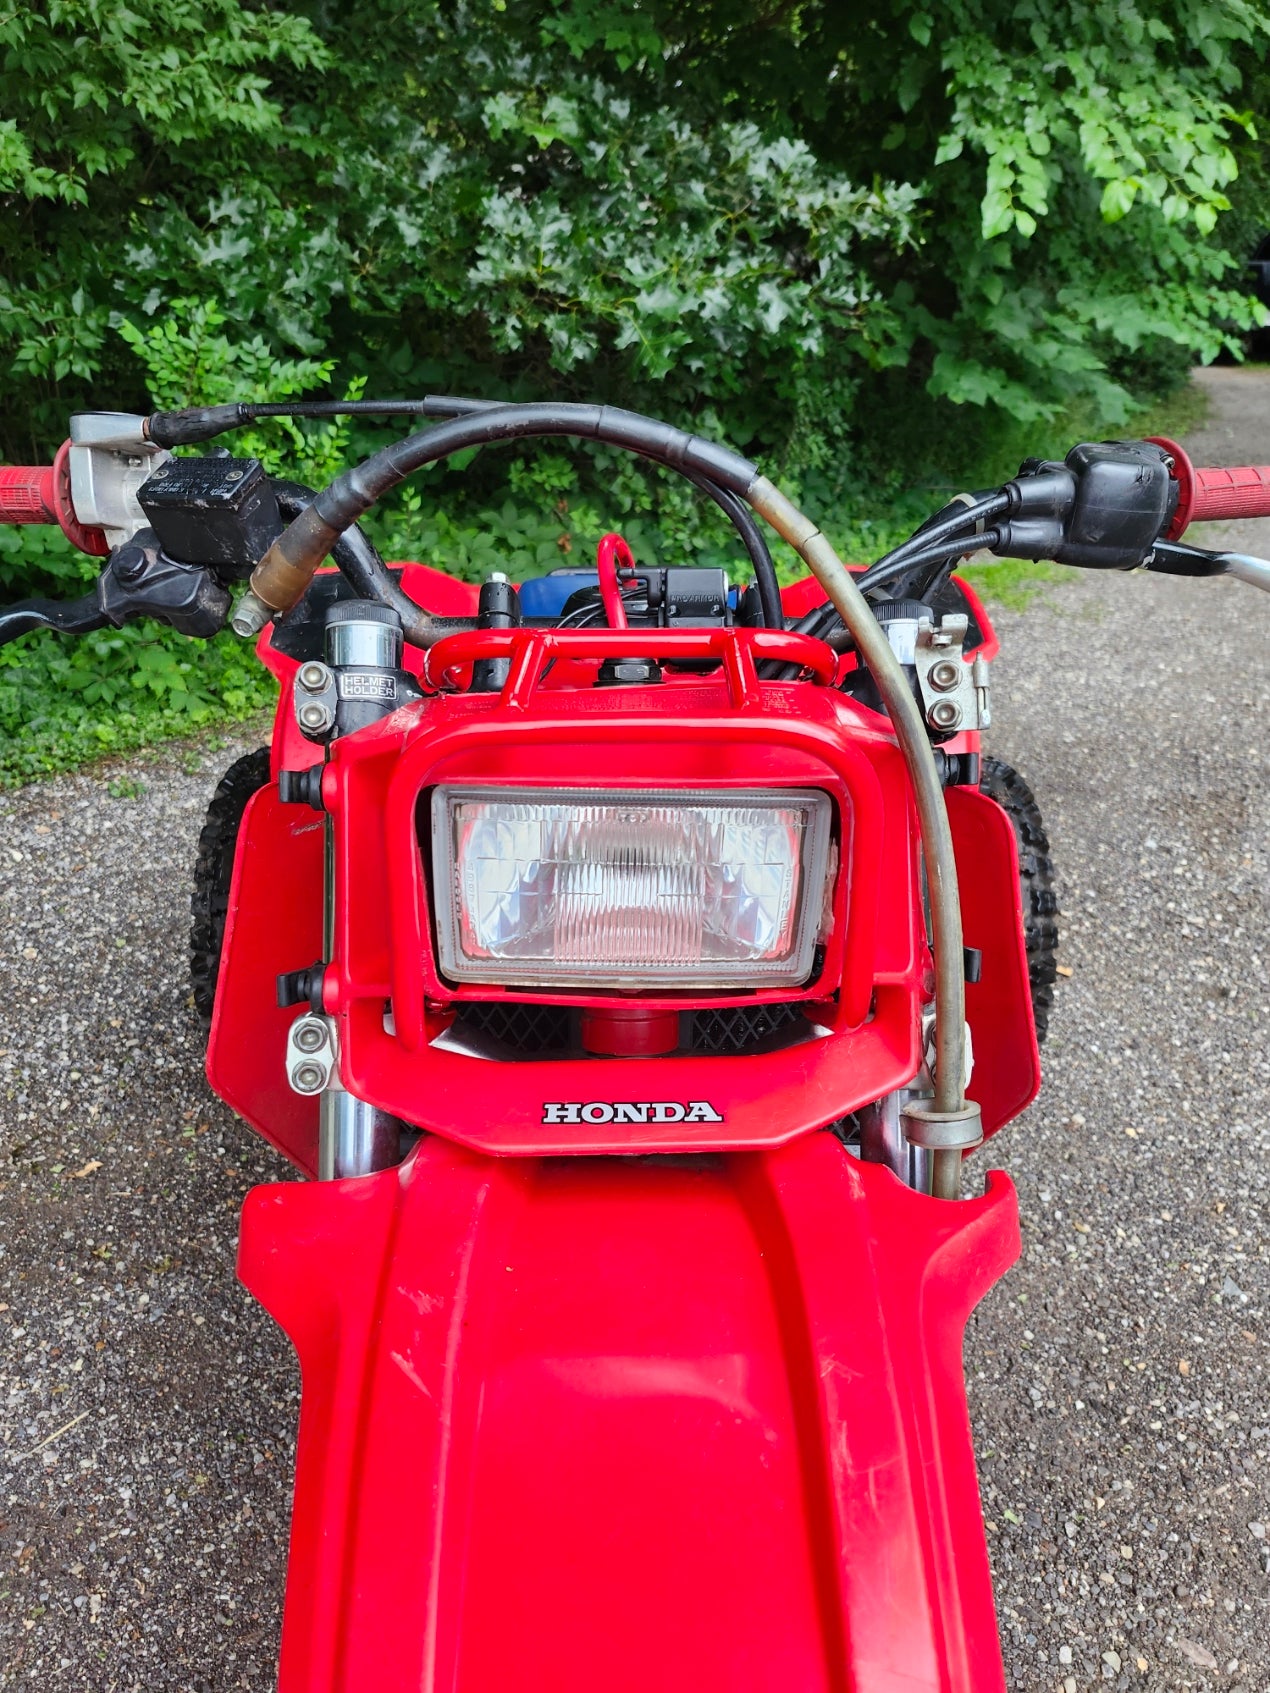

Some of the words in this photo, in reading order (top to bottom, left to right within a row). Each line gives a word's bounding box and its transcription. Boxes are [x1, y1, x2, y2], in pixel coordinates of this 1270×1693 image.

[345, 676, 393, 687] HELMET
[345, 686, 393, 697] HOLDER
[542, 1101, 724, 1125] HONDA
